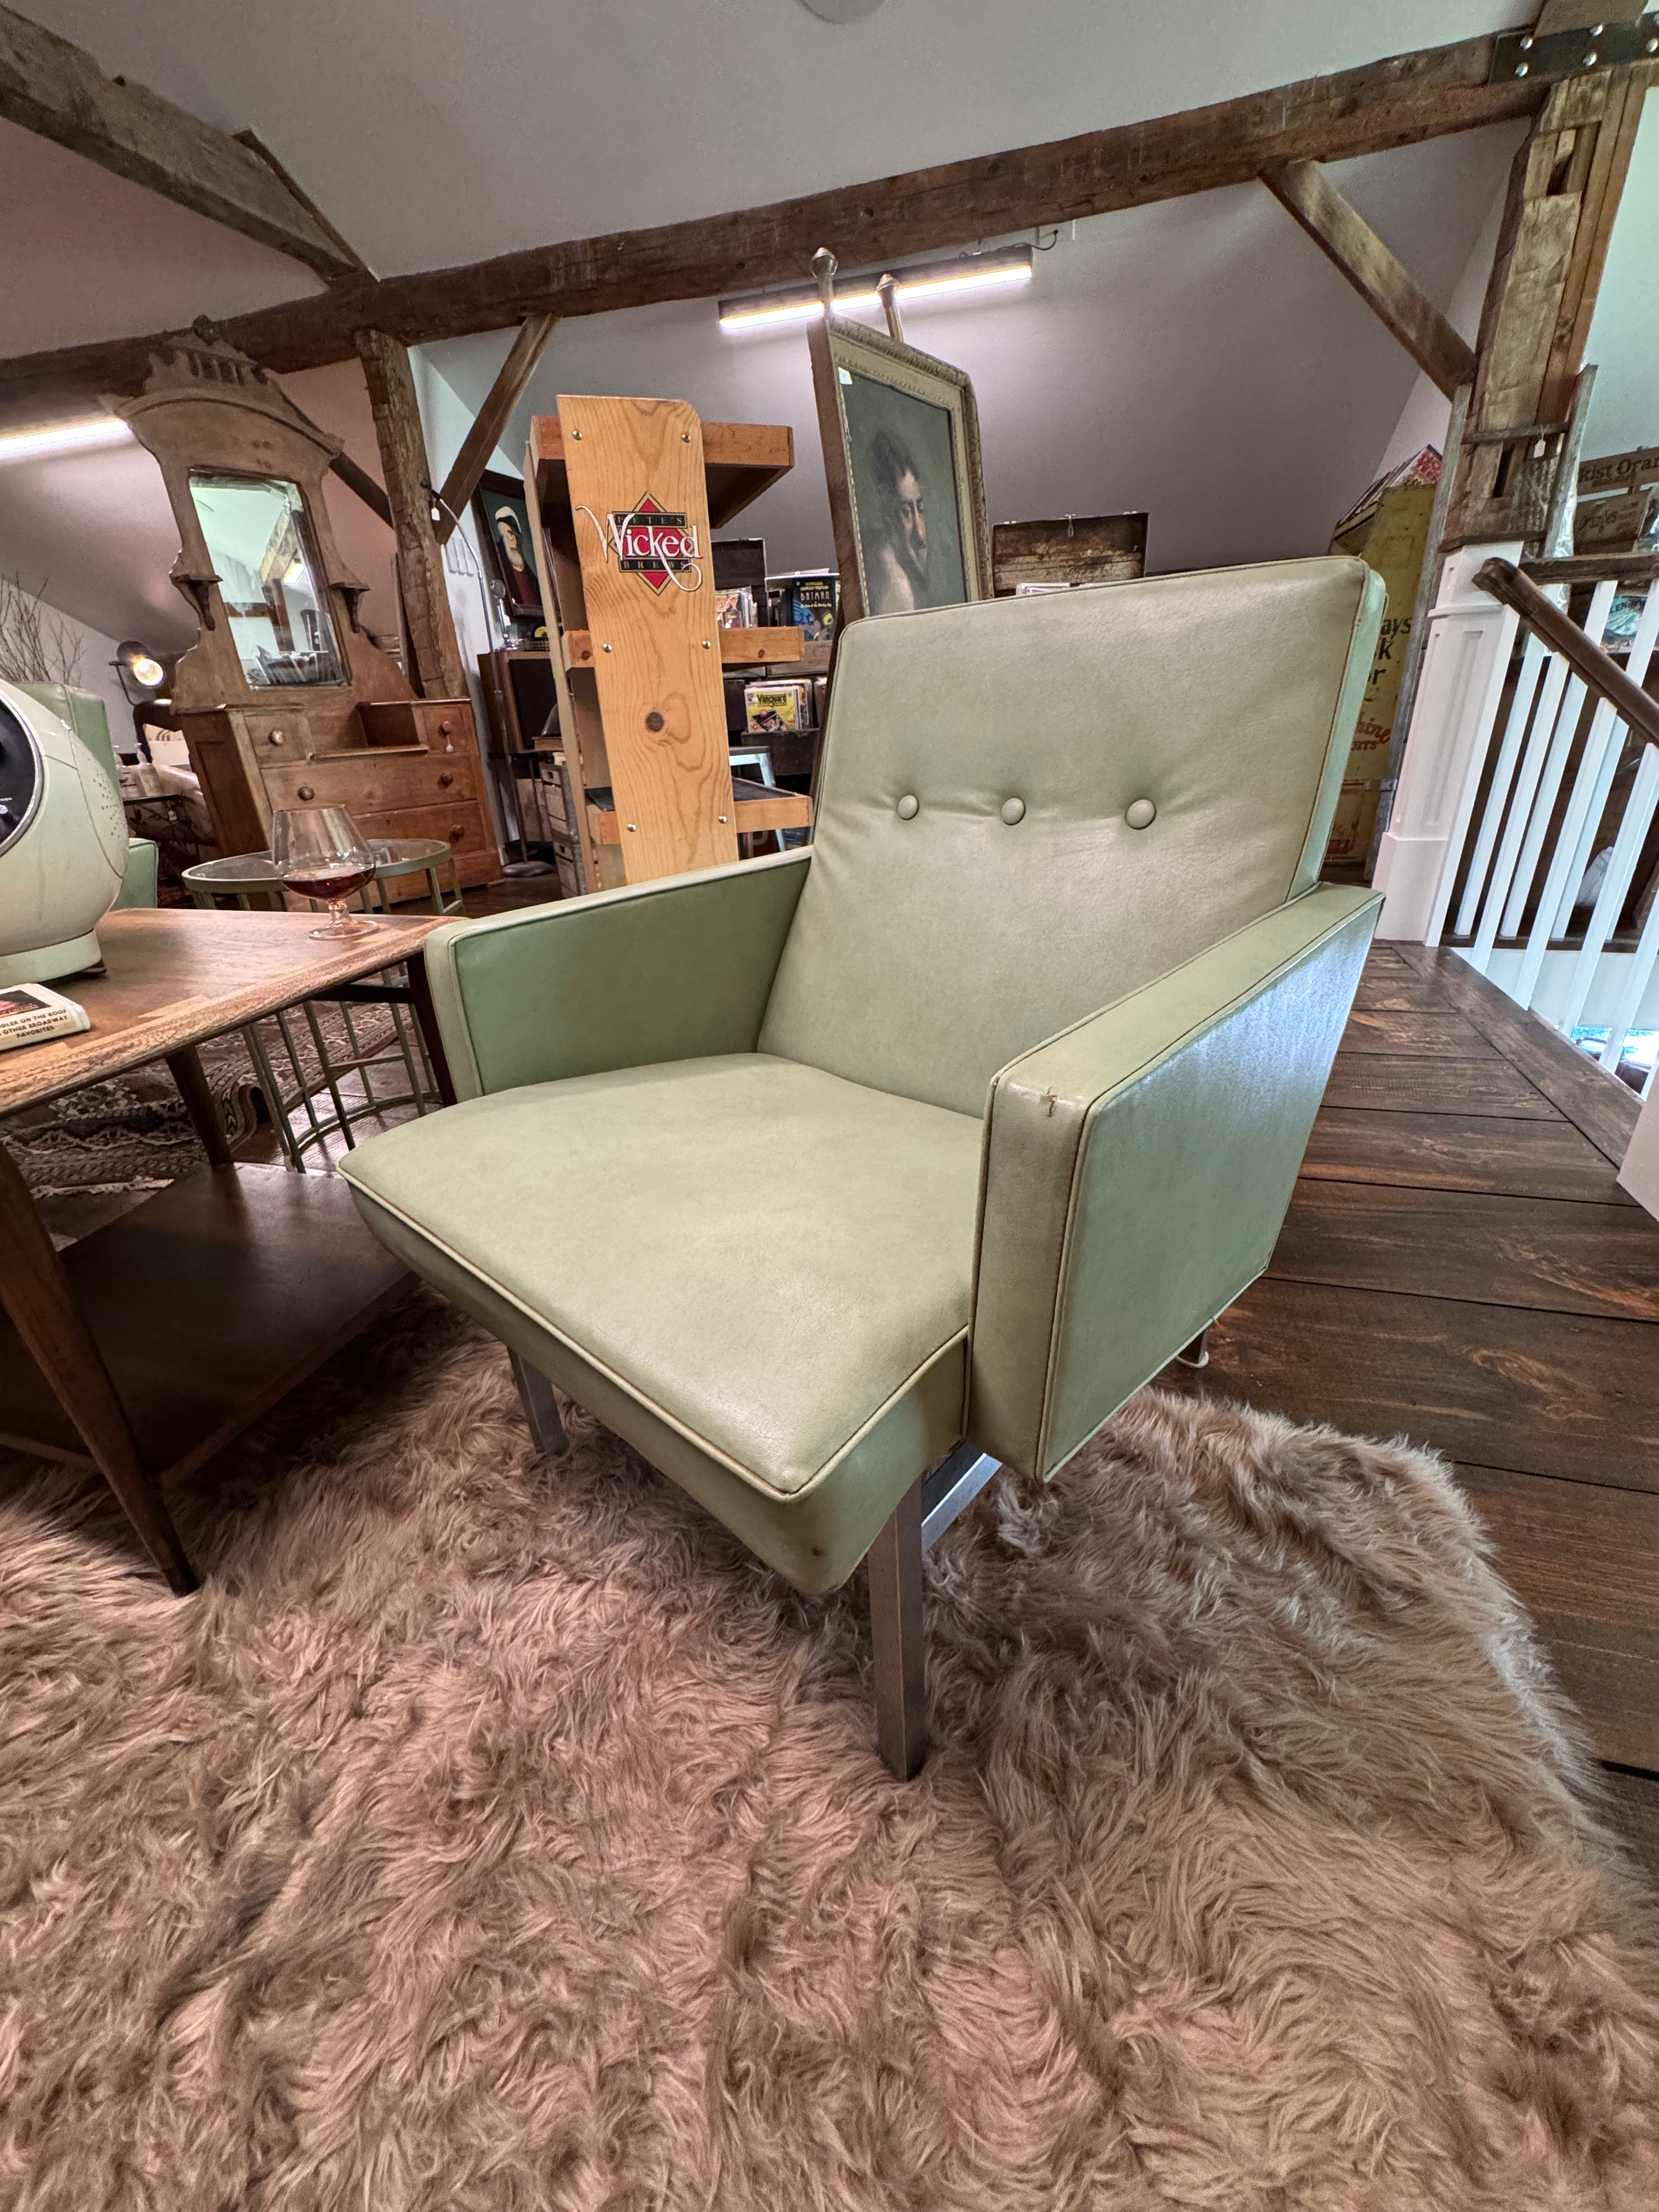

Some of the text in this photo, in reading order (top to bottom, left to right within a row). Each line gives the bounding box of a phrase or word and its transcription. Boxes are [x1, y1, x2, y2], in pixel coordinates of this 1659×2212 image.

[1578, 464, 1613, 483] kist
[617, 515, 682, 524] PETE'S
[575, 505, 703, 591] Wicked
[623, 560, 686, 569] BREWS
[800, 591, 830, 601] BATMAN
[1380, 617, 1413, 639] ays
[757, 693, 787, 707] Vanguard
[3, 1025, 27, 1034] OTHER
[28, 1015, 67, 1029] BROADWAY
[16, 1025, 54, 1038] FAVORITES
